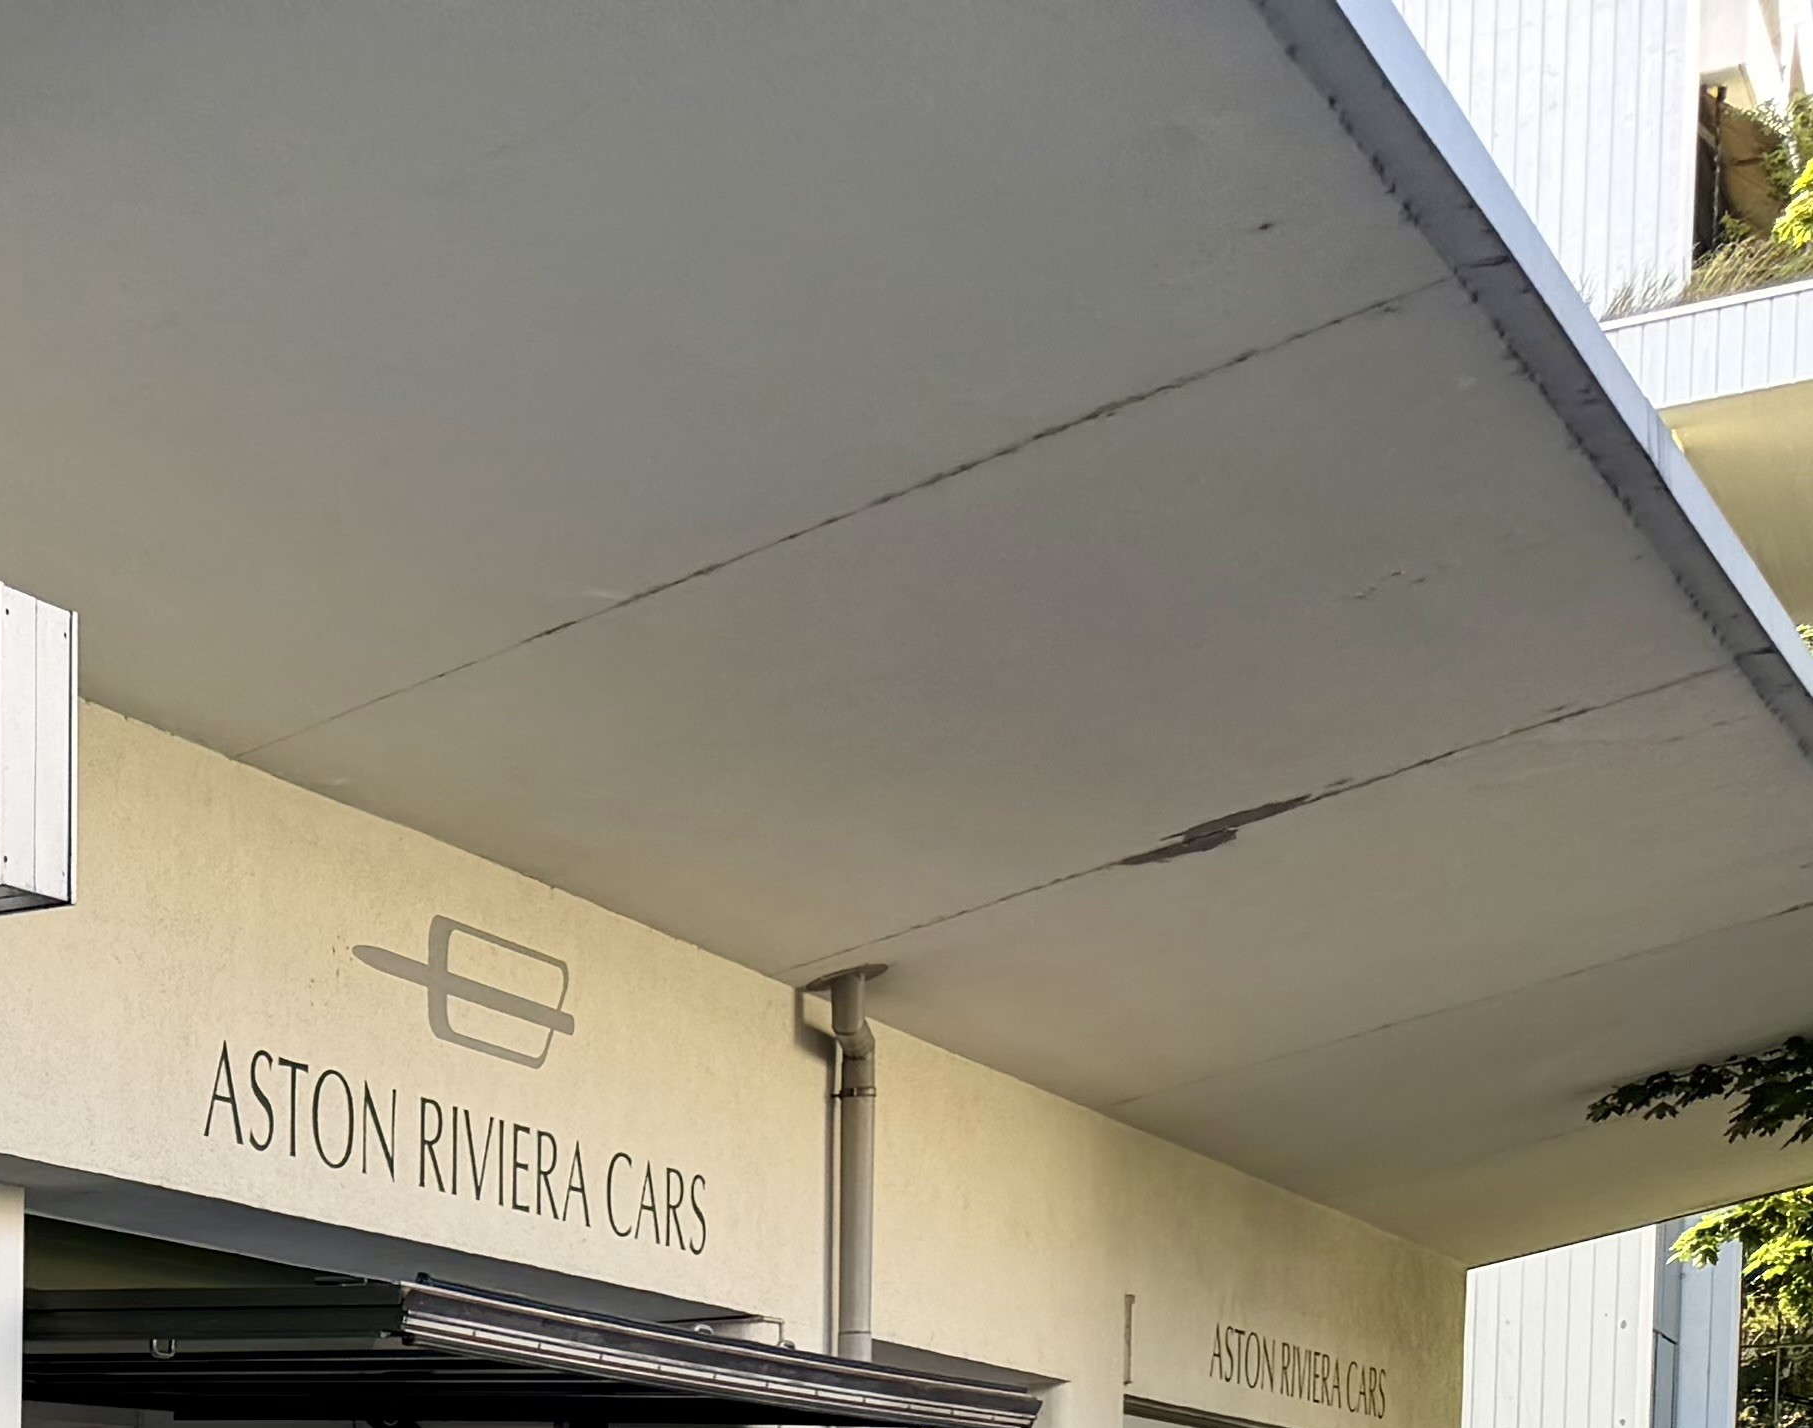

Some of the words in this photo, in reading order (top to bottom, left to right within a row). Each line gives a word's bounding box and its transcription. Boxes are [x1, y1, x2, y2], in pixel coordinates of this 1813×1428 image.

[203, 1039, 398, 1183] ASTON
[418, 1096, 592, 1229] RIVIERA
[605, 1152, 708, 1256] CARS
[1209, 1322, 1276, 1394] ASTON
[1280, 1342, 1342, 1409] RIVIERA
[1346, 1360, 1387, 1420] CARS
